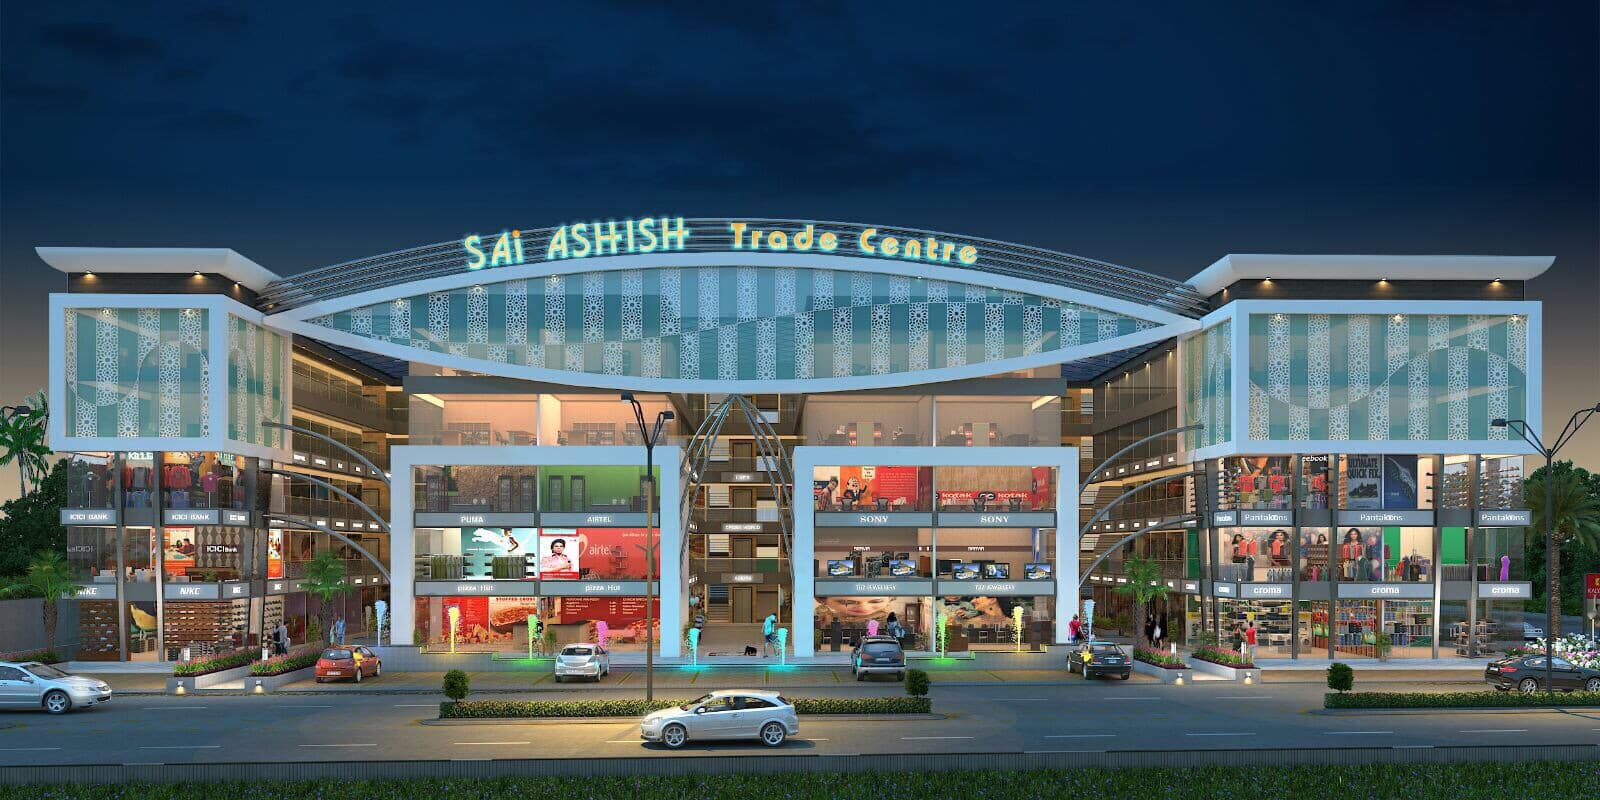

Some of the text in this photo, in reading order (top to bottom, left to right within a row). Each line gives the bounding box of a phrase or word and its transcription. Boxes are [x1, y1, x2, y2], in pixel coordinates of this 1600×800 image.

[547, 217, 690, 259] ASHISH
[730, 222, 838, 250] Trade
[860, 228, 978, 263] Centre
[981, 515, 1009, 523] SONY
[180, 587, 200, 595] NIKE
[586, 584, 604, 592] pizza
